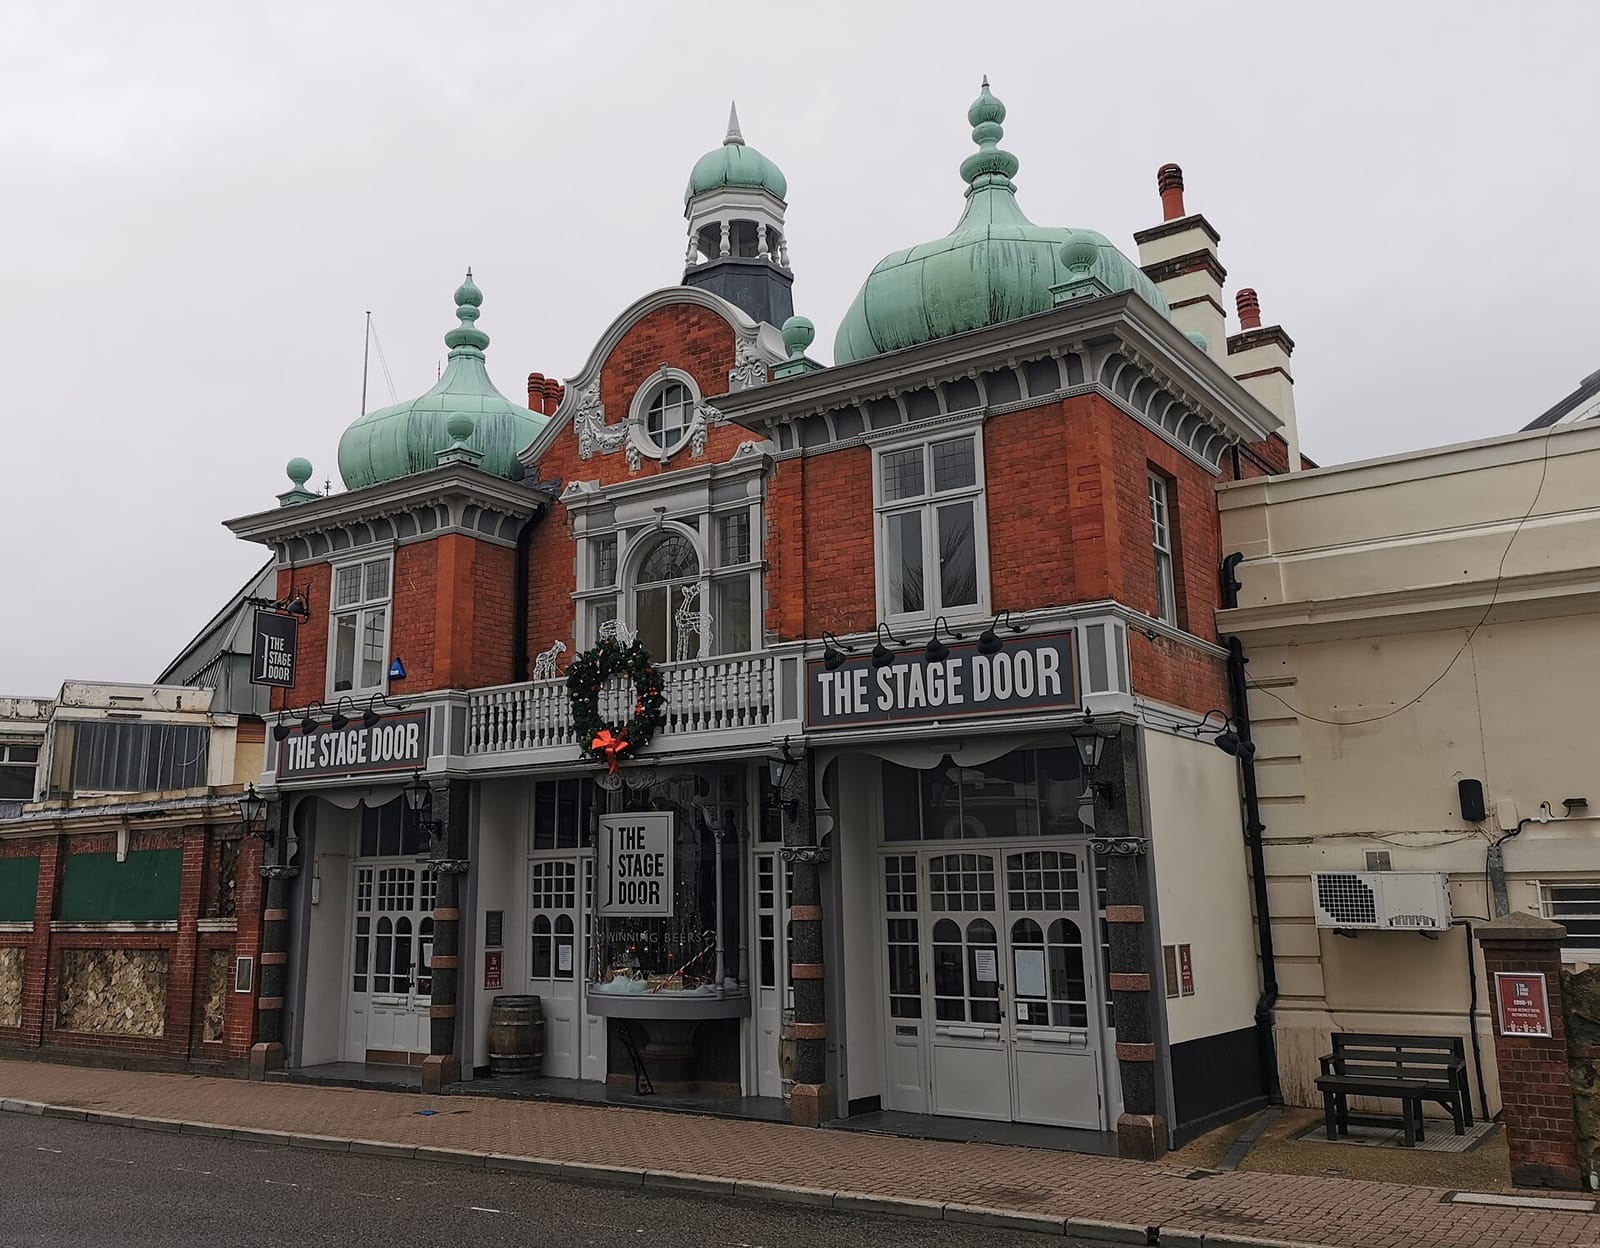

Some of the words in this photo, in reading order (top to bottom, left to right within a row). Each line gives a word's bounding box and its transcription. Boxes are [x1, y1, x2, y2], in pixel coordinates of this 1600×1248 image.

[270, 636, 285, 651] THE
[269, 651, 292, 667] STAGE
[268, 665, 290, 681] DOOR
[817, 668, 869, 716] THE
[876, 658, 964, 711] STAGE
[971, 647, 1062, 701] DOOR
[288, 735, 316, 770] THE
[319, 729, 368, 767] STAGE
[371, 723, 419, 762] DOOR
[618, 826, 646, 850] THE
[618, 853, 664, 878] STAGE
[618, 881, 660, 905] DOOR
[608, 932, 658, 943] WINNING
[664, 932, 702, 943] BEERS
